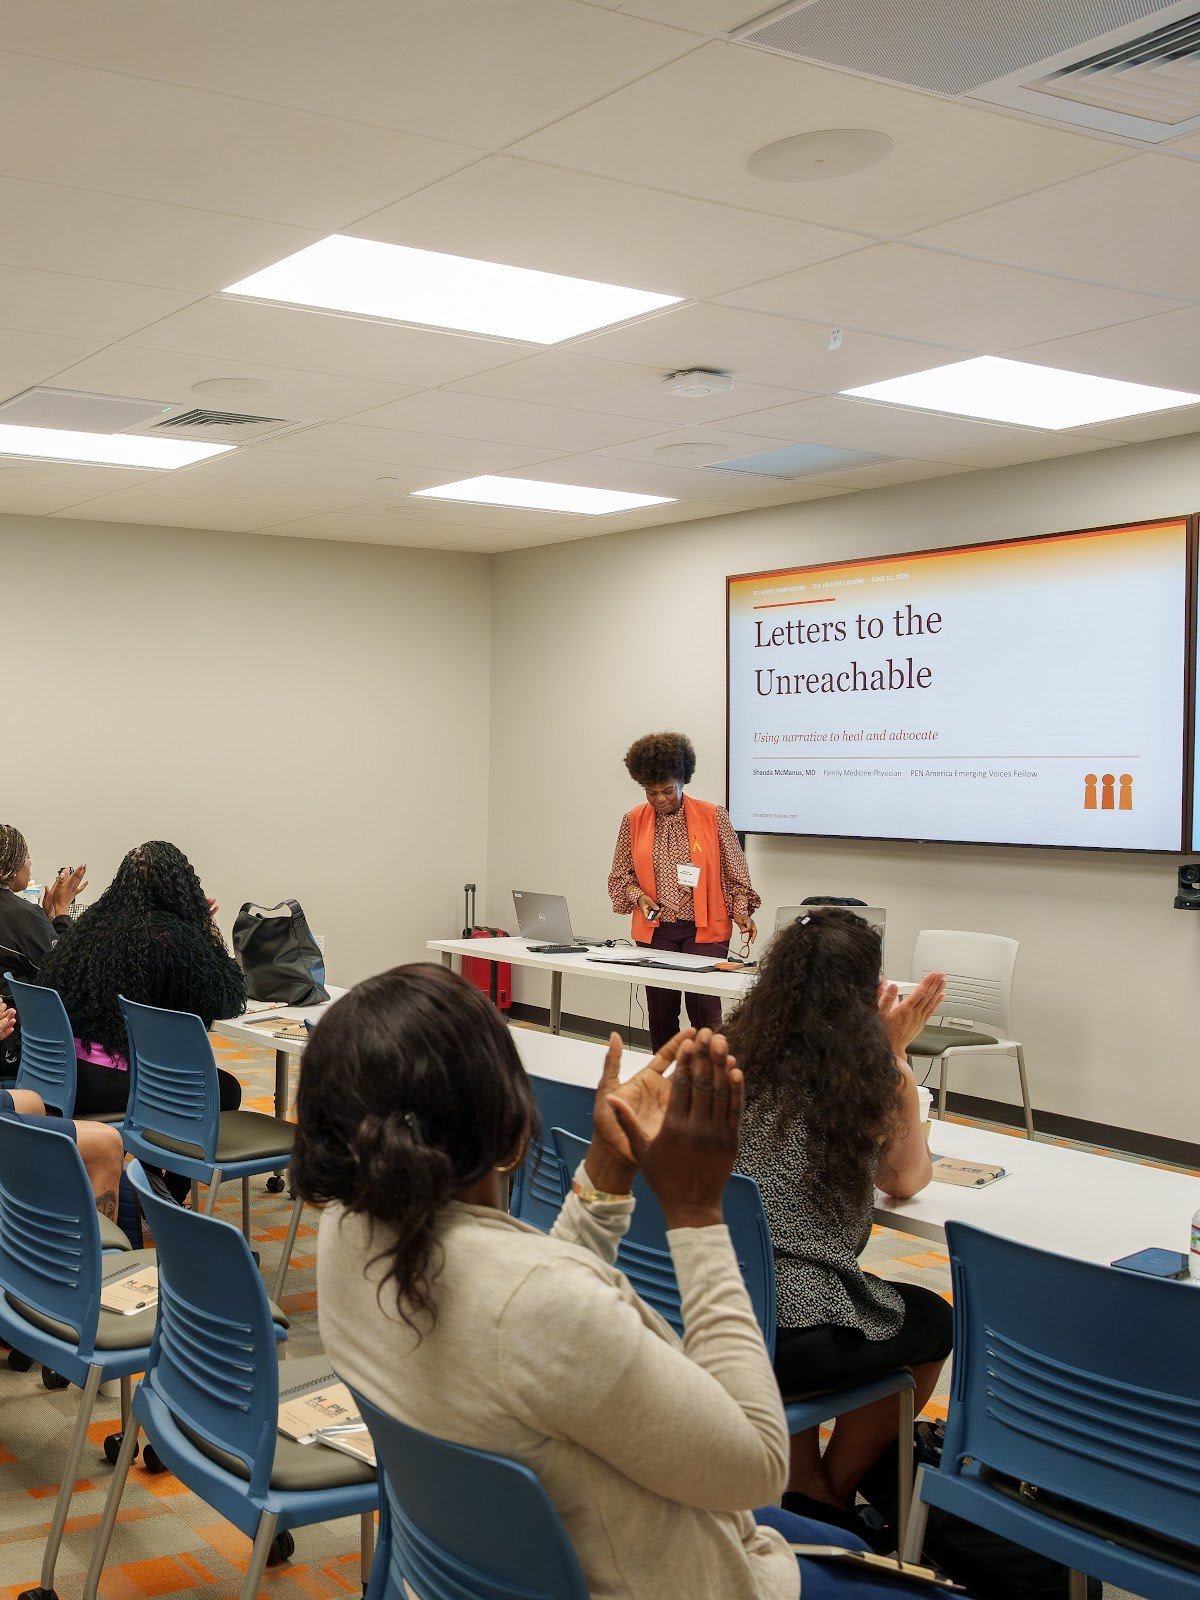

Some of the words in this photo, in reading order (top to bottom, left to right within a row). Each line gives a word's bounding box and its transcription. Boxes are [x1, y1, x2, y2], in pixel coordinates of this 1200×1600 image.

[775, 585, 806, 594] SYMPOSIUM
[823, 580, 846, 588] HEALING
[871, 575, 885, 583] JUNE
[755, 619, 847, 647] Letters
[855, 614, 884, 639] to
[893, 604, 942, 637] the
[755, 657, 932, 696] Unreachable
[753, 732, 780, 744] Using
[782, 731, 828, 742] narrative
[830, 732, 840, 742] to
[842, 730, 864, 742] heal
[866, 729, 887, 741] and
[889, 729, 938, 741] advocate
[774, 769, 804, 777] McManus,
[823, 769, 842, 778] Family
[843, 769, 872, 777] Medicine
[873, 769, 902, 778] Physician
[910, 769, 924, 777] PEN
[925, 770, 953, 778] America
[954, 769, 987, 779] Emerging
[988, 770, 1012, 778] Voices
[1013, 769, 1038, 778] Fellow
